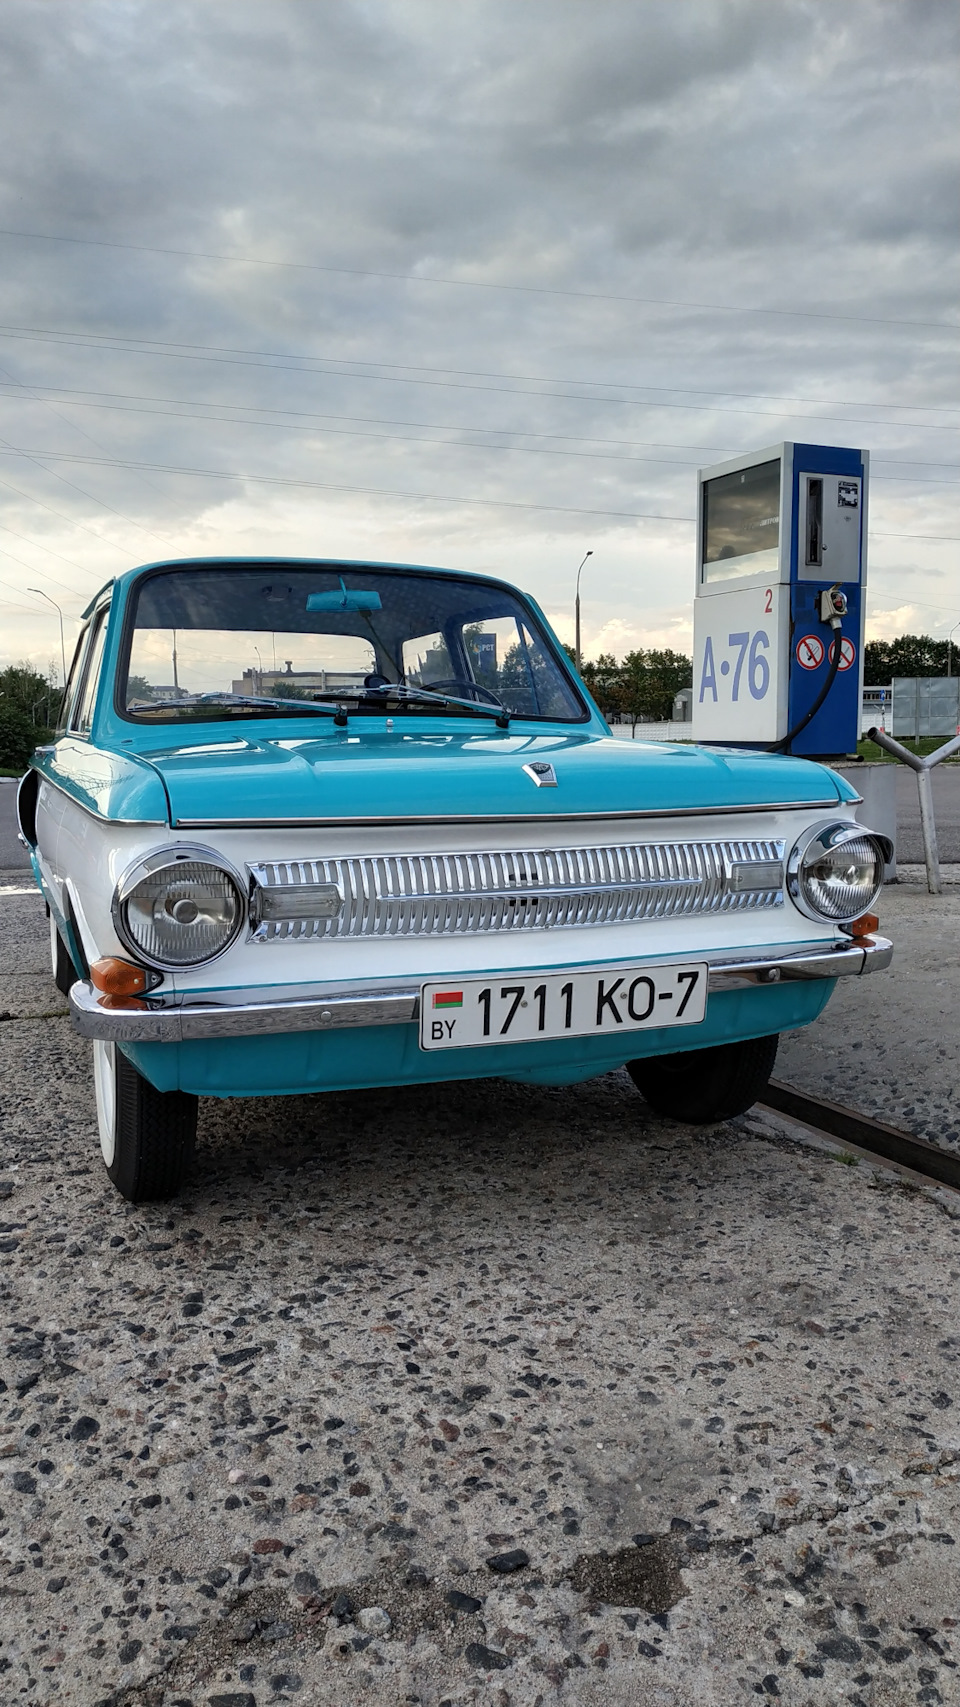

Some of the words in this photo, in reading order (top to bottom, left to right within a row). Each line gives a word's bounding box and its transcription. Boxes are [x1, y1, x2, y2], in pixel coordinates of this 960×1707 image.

[764, 588, 773, 613] 2
[477, 982, 574, 1036] 1711
[595, 971, 700, 1026] KO-7
[431, 1019, 457, 1041] BY
